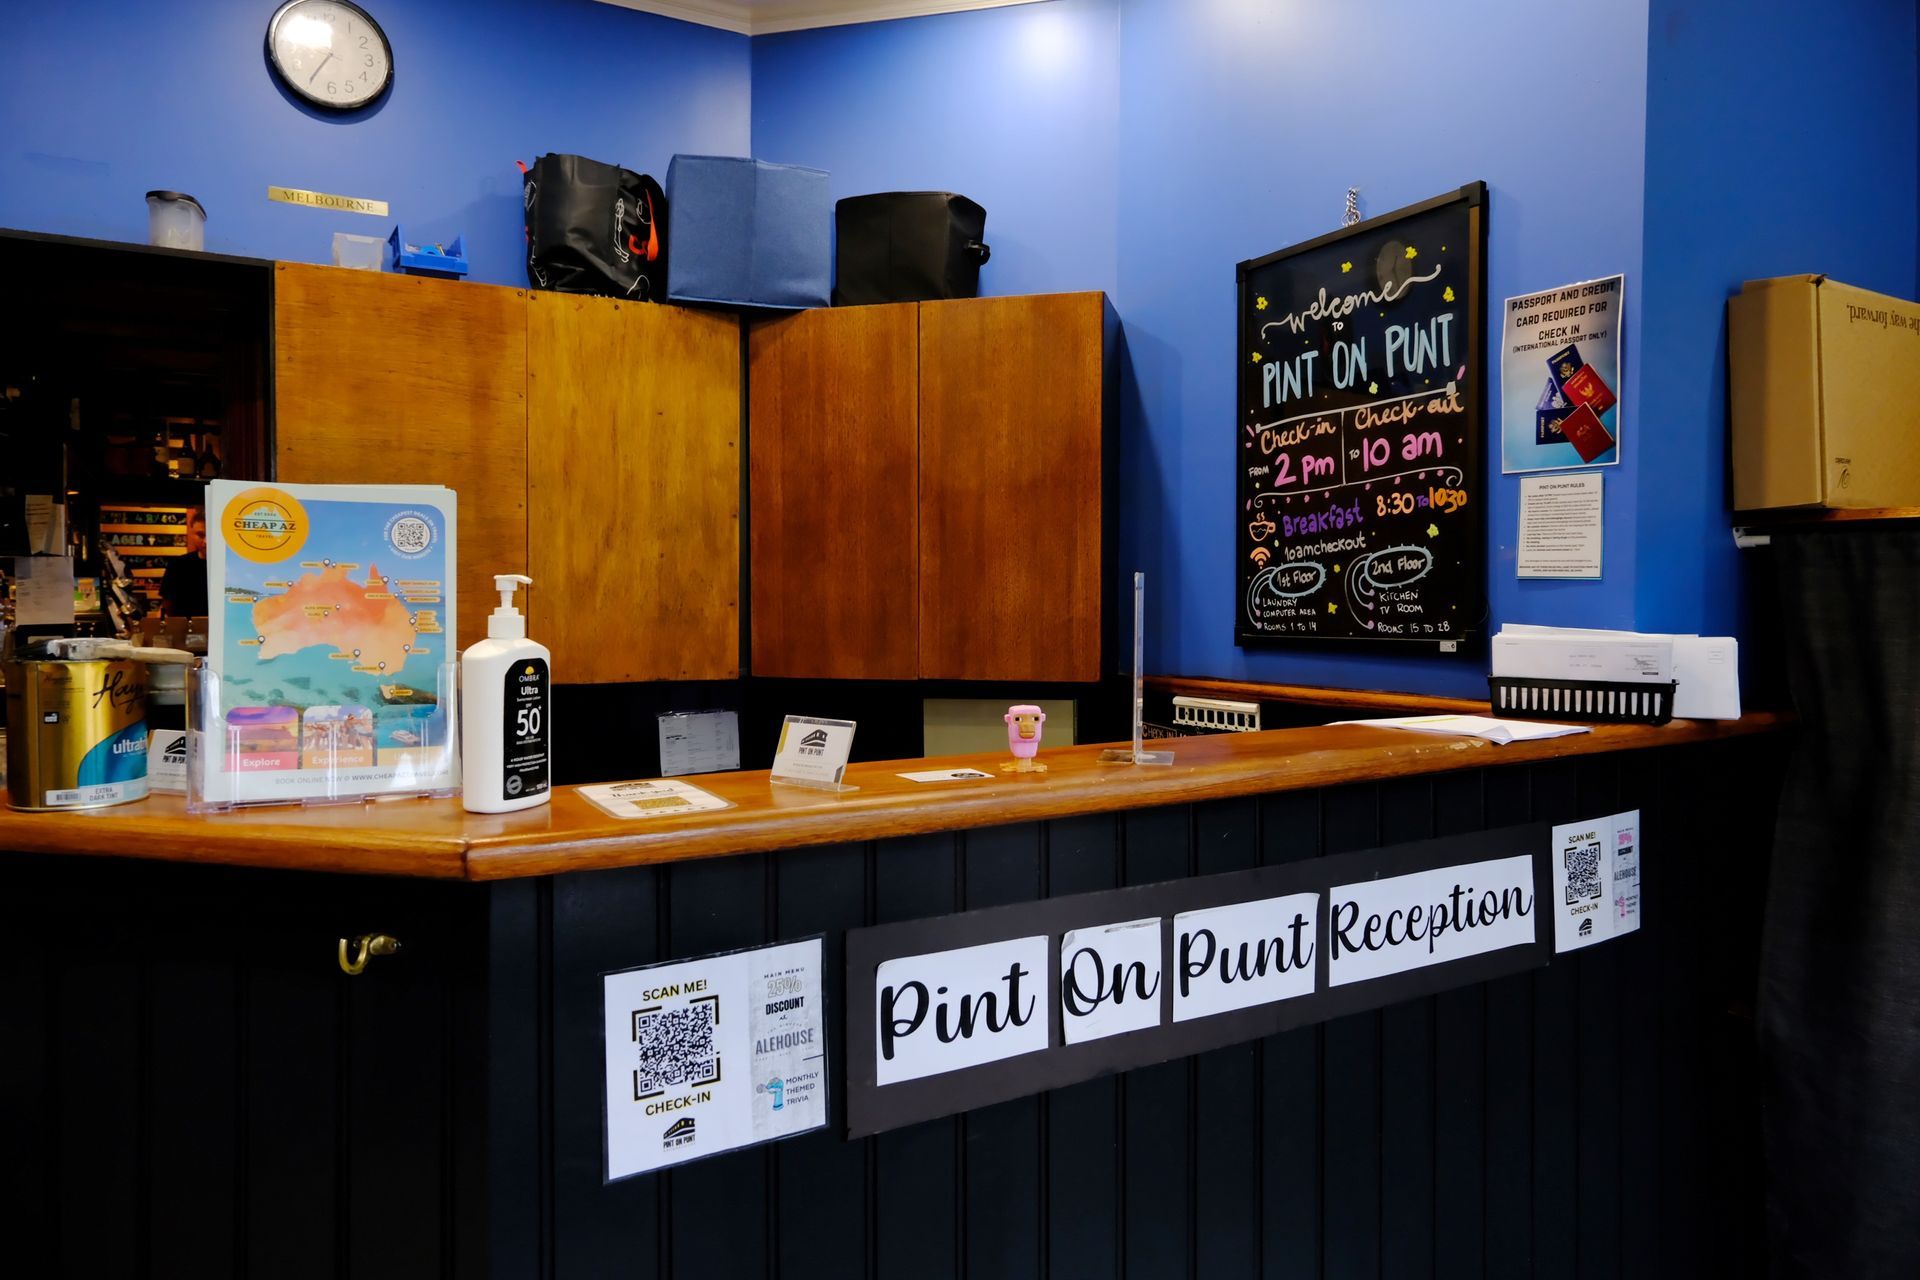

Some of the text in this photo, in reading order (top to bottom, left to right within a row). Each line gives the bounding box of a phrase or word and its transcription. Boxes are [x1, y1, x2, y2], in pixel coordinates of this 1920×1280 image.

[358, 36, 368, 49] 2
[364, 54, 374, 67] 3
[358, 71, 368, 82] 4
[327, 82, 337, 95] 6
[344, 81, 354, 93] 5
[282, 191, 374, 212] MELBOURNE
[1511, 281, 1616, 312] PASSPORT AND CREDIT
[1516, 301, 1608, 328] CARD REQUIRED FOR
[1846, 304, 1920, 336] he way forward.
[1331, 321, 1344, 332] TO
[1538, 324, 1580, 341] CHECK IN
[1512, 338, 1559, 354] (INTERNATIONAL
[1588, 331, 1608, 341] ONLY)
[1263, 313, 1454, 409] PINT ON PUNT
[1261, 418, 1336, 455] Check-in
[1362, 436, 1390, 472] 10
[1401, 431, 1444, 461] am
[1248, 465, 1269, 478] FROM
[1273, 453, 1297, 488] 2
[1282, 497, 1365, 537] Breakfast
[1376, 492, 1415, 517] 8:30
[234, 520, 297, 531] CHEAP AZ
[112, 534, 144, 546] AGER
[1371, 555, 1426, 575] 2nd Floor
[1277, 569, 1317, 587] 1st Floor
[1262, 597, 1298, 607] LAUNDRY
[1263, 608, 1317, 618] COMPUTER AREA
[1379, 603, 1424, 615] TV ROOM
[1308, 621, 1317, 631] 14
[1409, 623, 1420, 633] 15
[1438, 621, 1451, 632] 28
[520, 686, 539, 696] Ultra
[242, 757, 281, 768] Explore
[274, 777, 295, 785] BOOK
[297, 776, 323, 785] ONLINE
[89, 792, 119, 802] DARK TINT
[95, 787, 113, 795] EXTRA
[1568, 831, 1596, 844] SCAN ME!
[1570, 902, 1599, 916] CHECK-IN
[764, 967, 805, 979] MAIN MENU
[880, 880, 1533, 1061] Pint On Punt Reception
[642, 979, 707, 1002] SCAN ME!
[768, 976, 803, 998] 25%
[765, 996, 805, 1016] DISCOUNT
[756, 1028, 815, 1055] ALEHOUSE
[786, 1072, 819, 1085] MONTHLY
[786, 1083, 816, 1095] THEMED
[645, 1091, 711, 1117] CHECK-IN
[786, 1095, 809, 1106] TRIVIA
[663, 1135, 695, 1149] PINT ON PUNT
